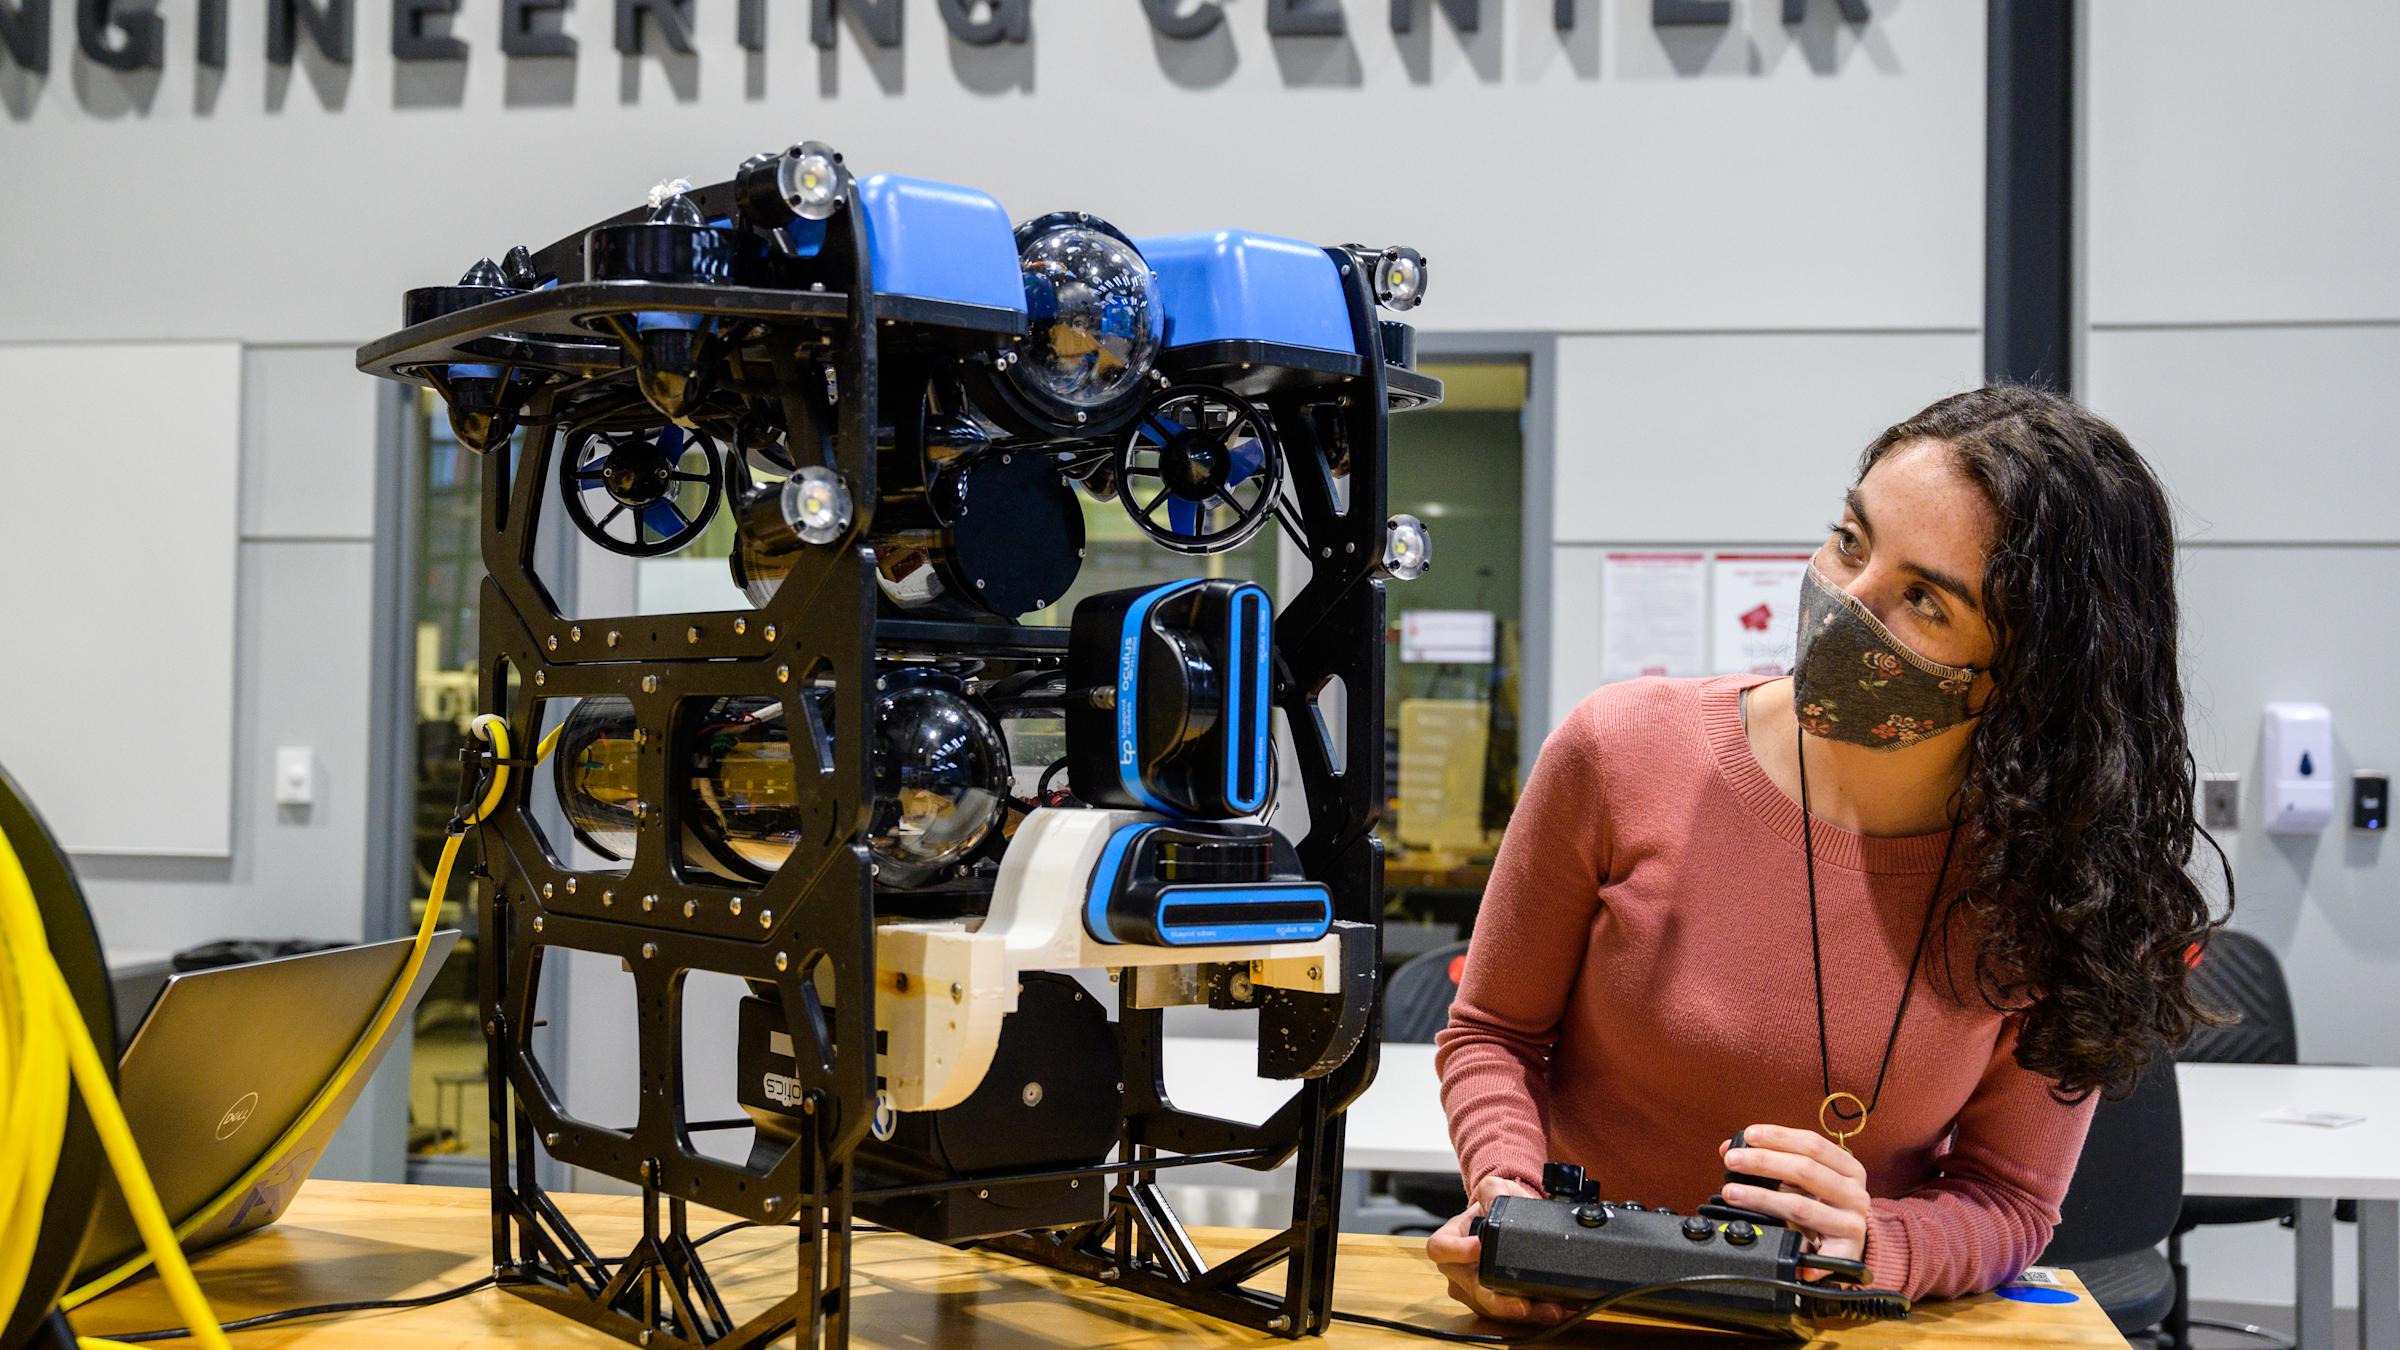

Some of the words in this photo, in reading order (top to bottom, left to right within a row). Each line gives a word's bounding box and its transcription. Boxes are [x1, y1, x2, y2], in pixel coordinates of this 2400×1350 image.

[1122, 637, 1132, 690] oculus
[1120, 740, 1135, 765] bp
[223, 1109, 249, 1126] DELL
